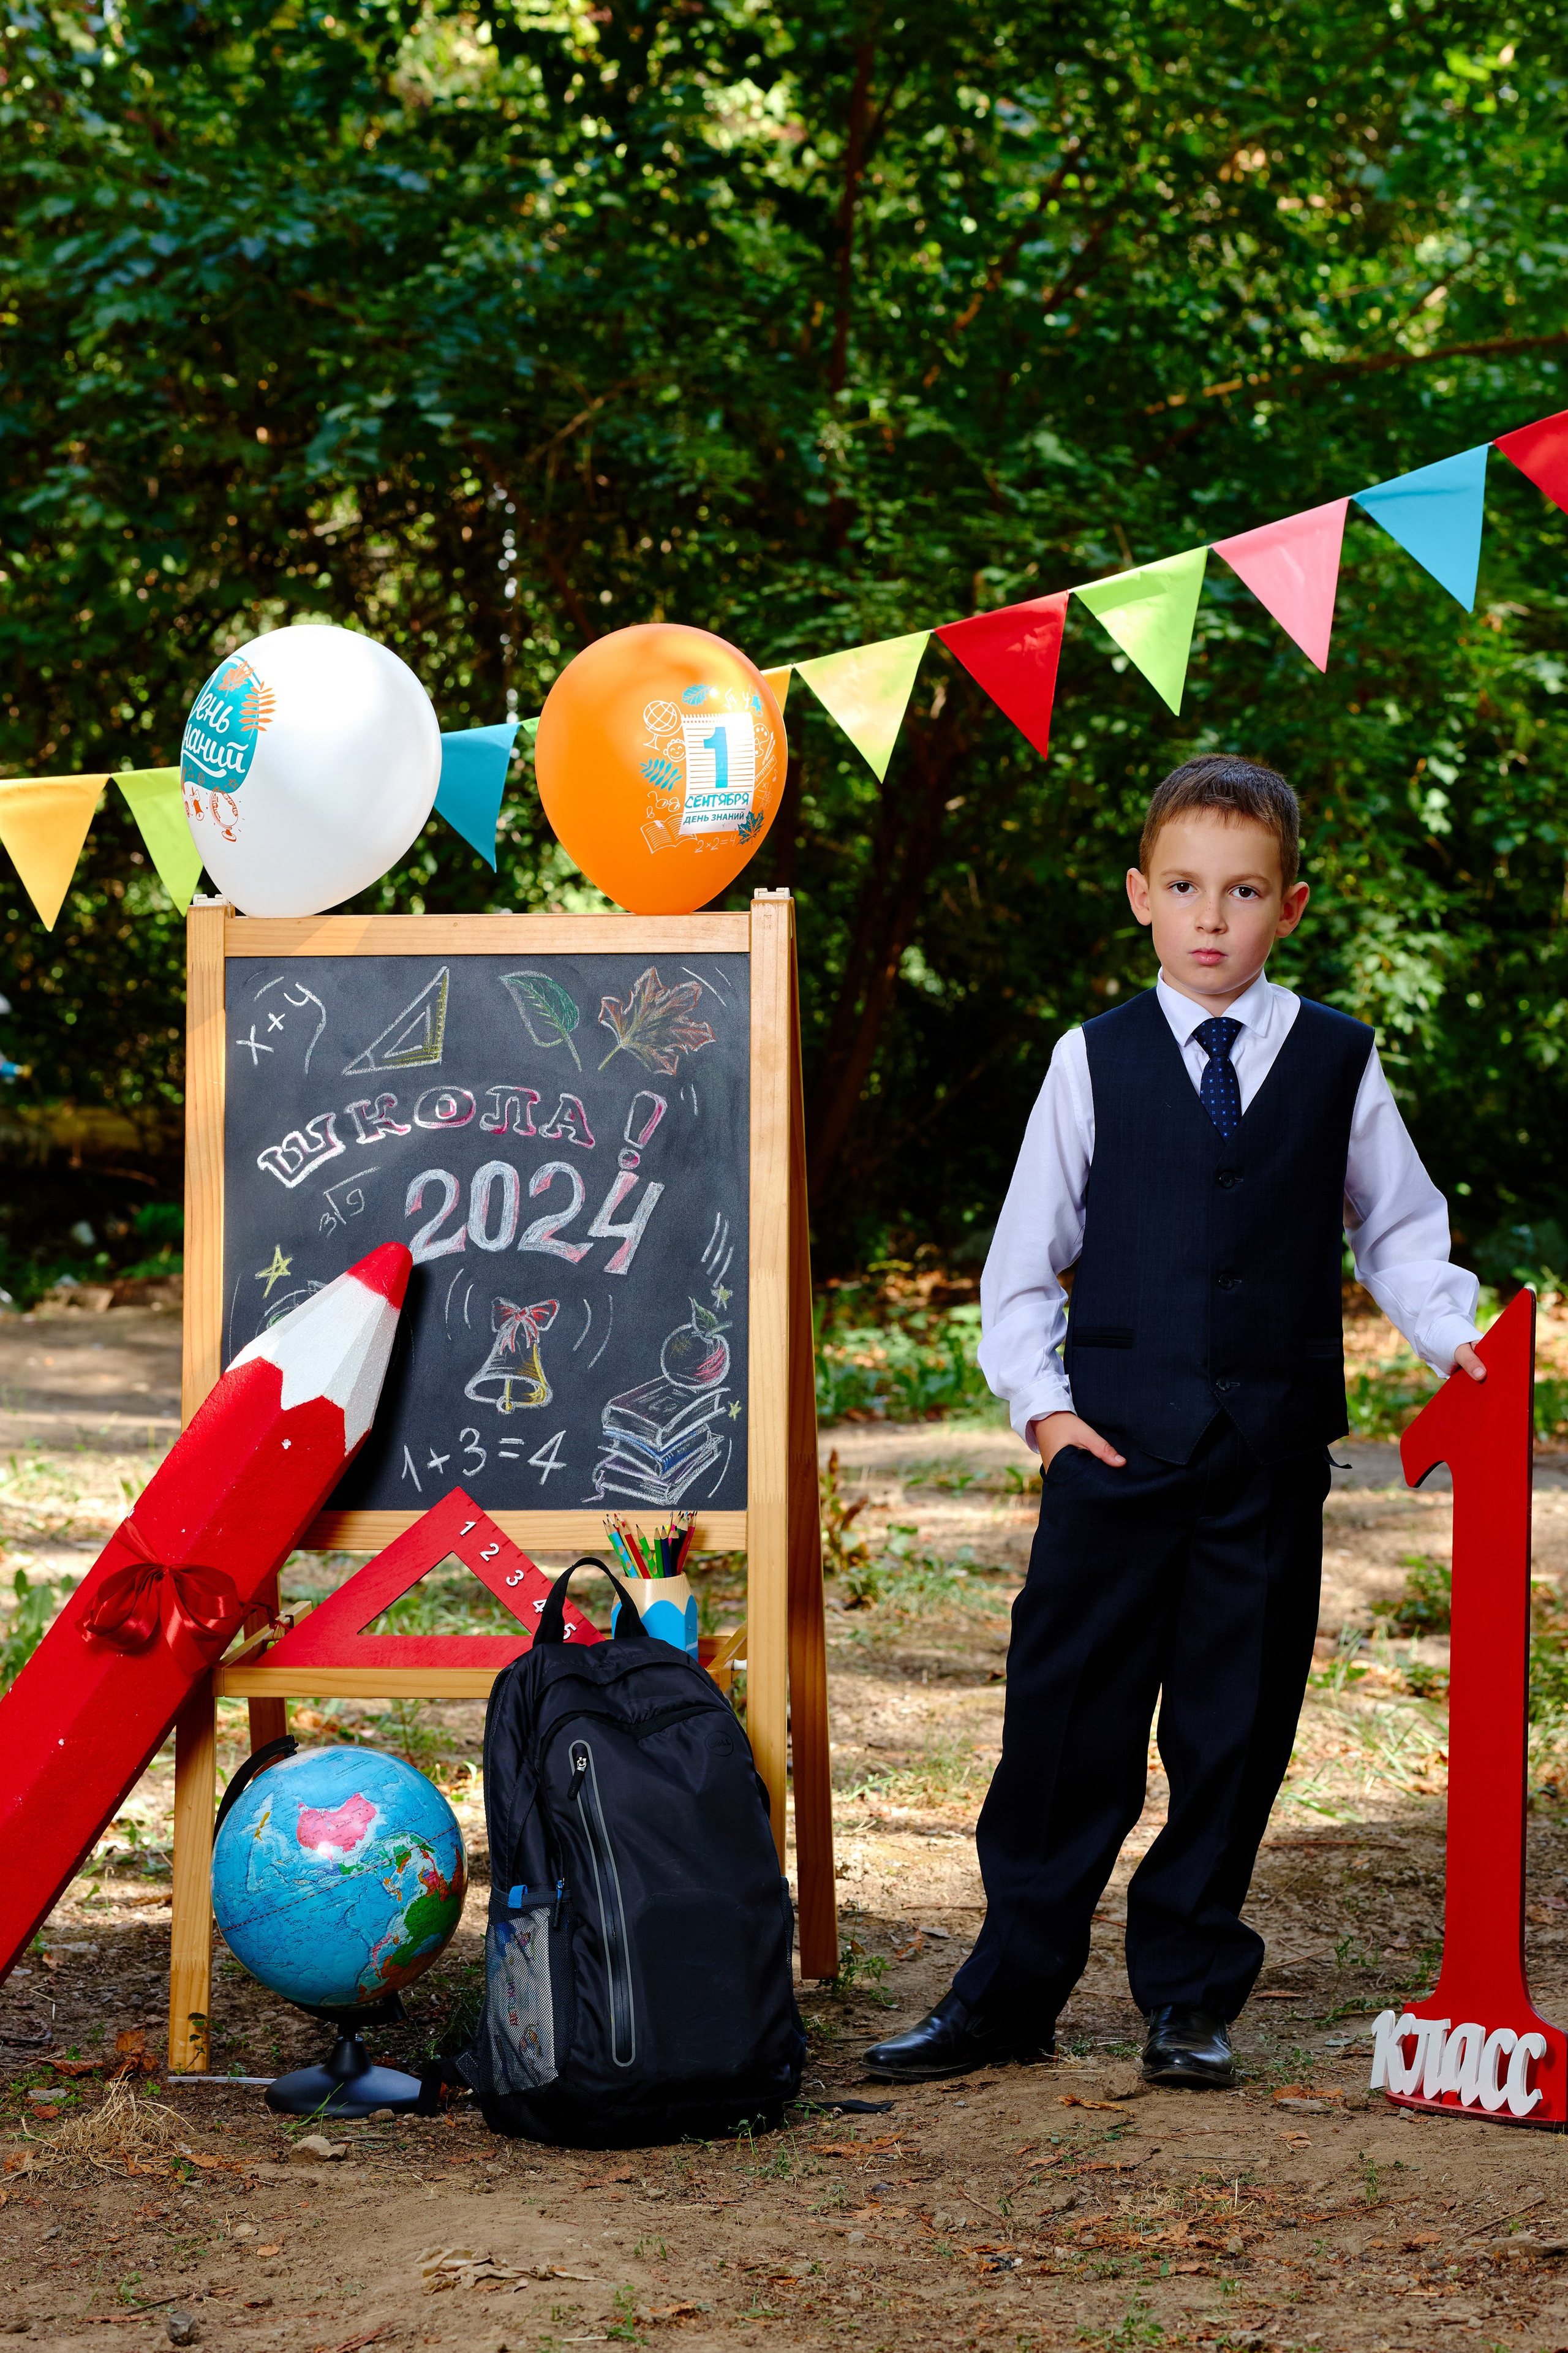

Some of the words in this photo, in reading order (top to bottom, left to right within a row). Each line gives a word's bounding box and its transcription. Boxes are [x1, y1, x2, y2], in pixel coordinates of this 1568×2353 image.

[183, 723, 249, 774] наний
[703, 727, 728, 788] 1
[683, 814, 709, 825] ДЕНЬ
[711, 811, 745, 821] ЗНАНИЙ
[684, 792, 750, 809] СЕНТЯБРЯ
[404, 1160, 666, 1275] 2024
[459, 1520, 477, 1536] 1
[480, 1543, 500, 1562] 2
[505, 1569, 525, 1587] 3
[532, 1598, 548, 1614] 4
[562, 1622, 577, 1640] 5
